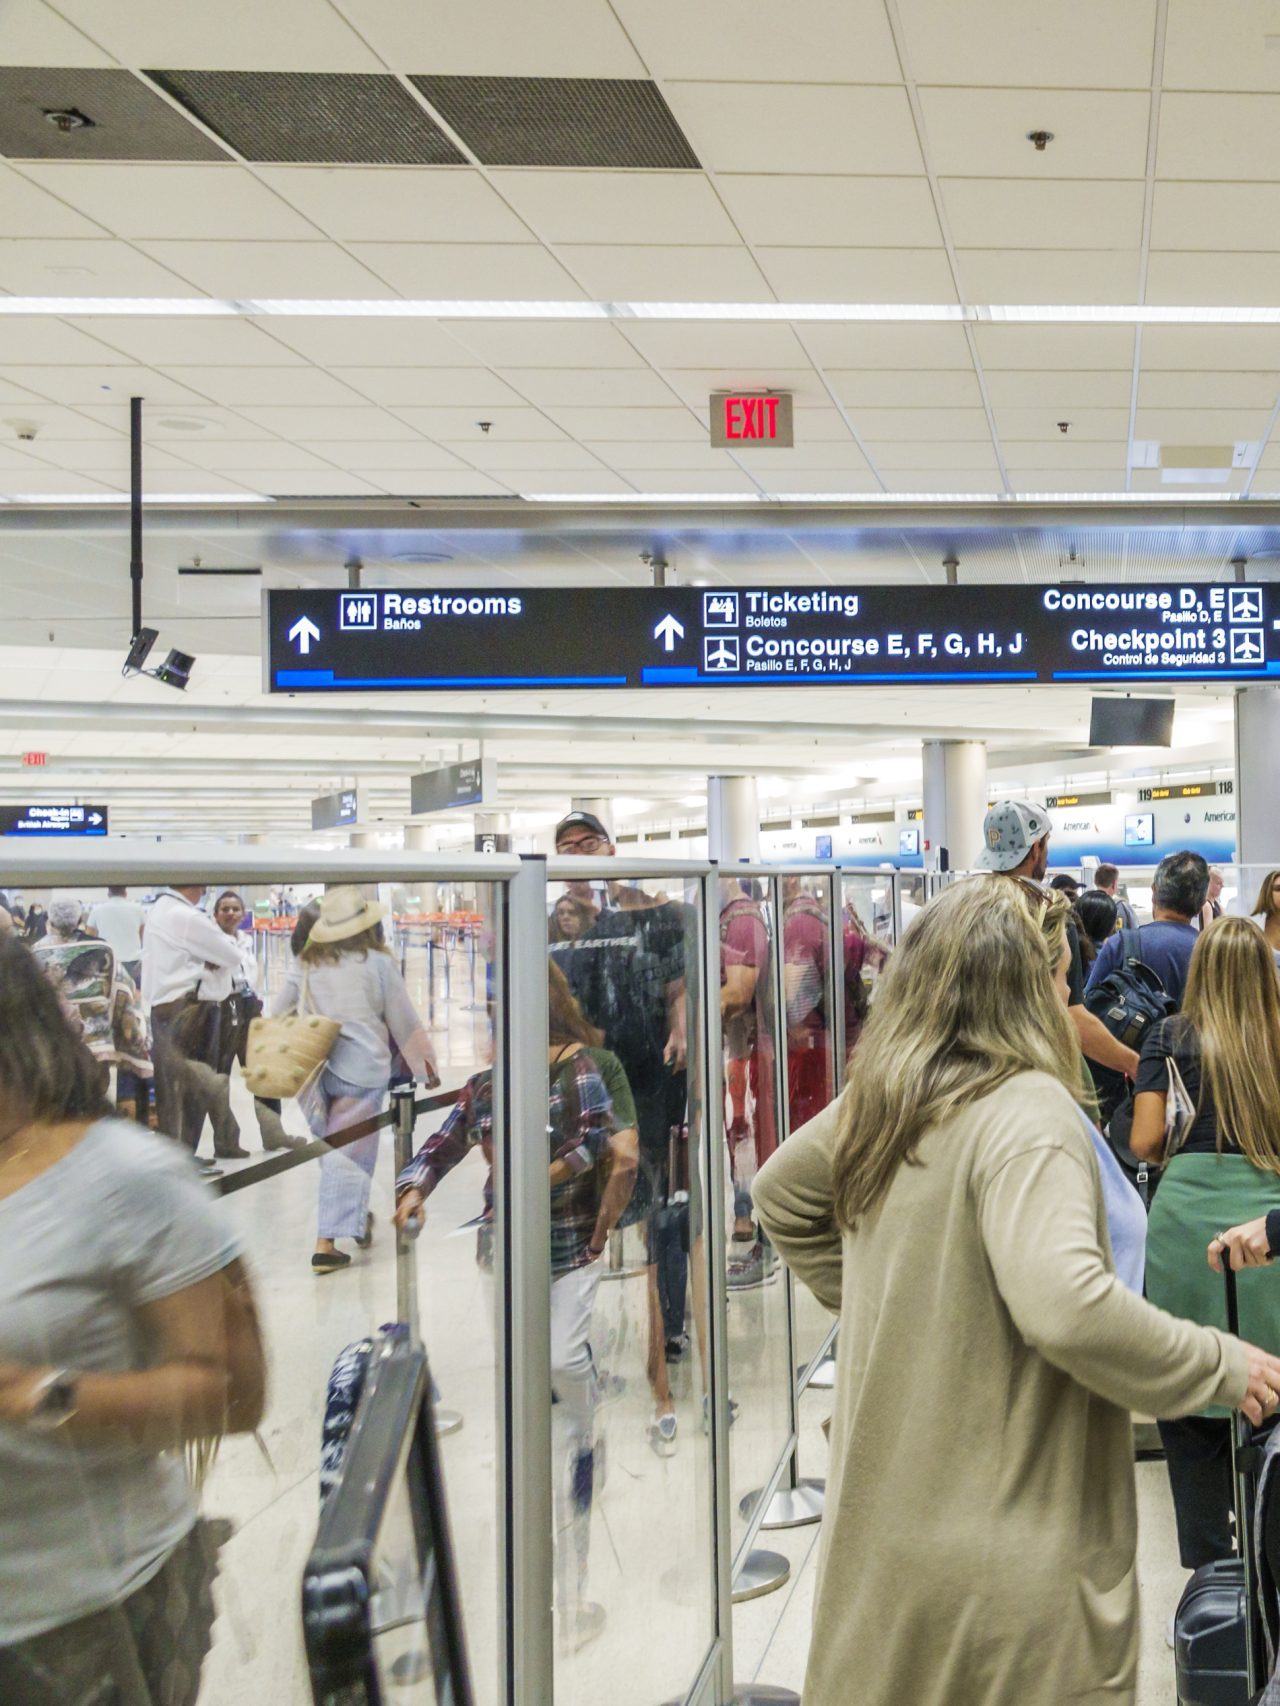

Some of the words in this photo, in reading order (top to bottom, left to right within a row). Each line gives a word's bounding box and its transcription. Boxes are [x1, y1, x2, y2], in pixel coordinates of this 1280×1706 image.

[725, 398, 780, 439] EXIT
[384, 594, 521, 614] Restrooms
[746, 591, 858, 616] Ticketing
[1044, 589, 1172, 610] Concourse
[1180, 588, 1202, 612] D,
[1210, 588, 1225, 608] E
[384, 618, 421, 630] Baños
[746, 616, 787, 627] Boletos
[1162, 610, 1197, 623] Pasillo
[1199, 611, 1211, 624] D,
[1214, 610, 1222, 622] E
[746, 635, 879, 656] Concourse
[888, 634, 910, 658] E,
[918, 634, 937, 658] F,
[944, 633, 970, 658] G,
[978, 632, 1002, 657] H,
[1009, 632, 1022, 654] J
[1071, 628, 1206, 653] Checkpoint
[1212, 628, 1226, 648] 3
[747, 660, 782, 671] Pasillo
[786, 659, 797, 672] E,
[801, 659, 810, 672] F,
[813, 659, 826, 672] G,
[829, 659, 841, 672] H,
[844, 658, 851, 670] J
[1103, 653, 1142, 665] Control
[1145, 653, 1158, 664] de
[1161, 652, 1216, 666] Seguridad
[1217, 652, 1226, 664] 3
[27, 752, 46, 766] EXIT
[1138, 788, 1152, 800] 119
[1219, 781, 1232, 794] 118
[28, 807, 70, 817] Check-in
